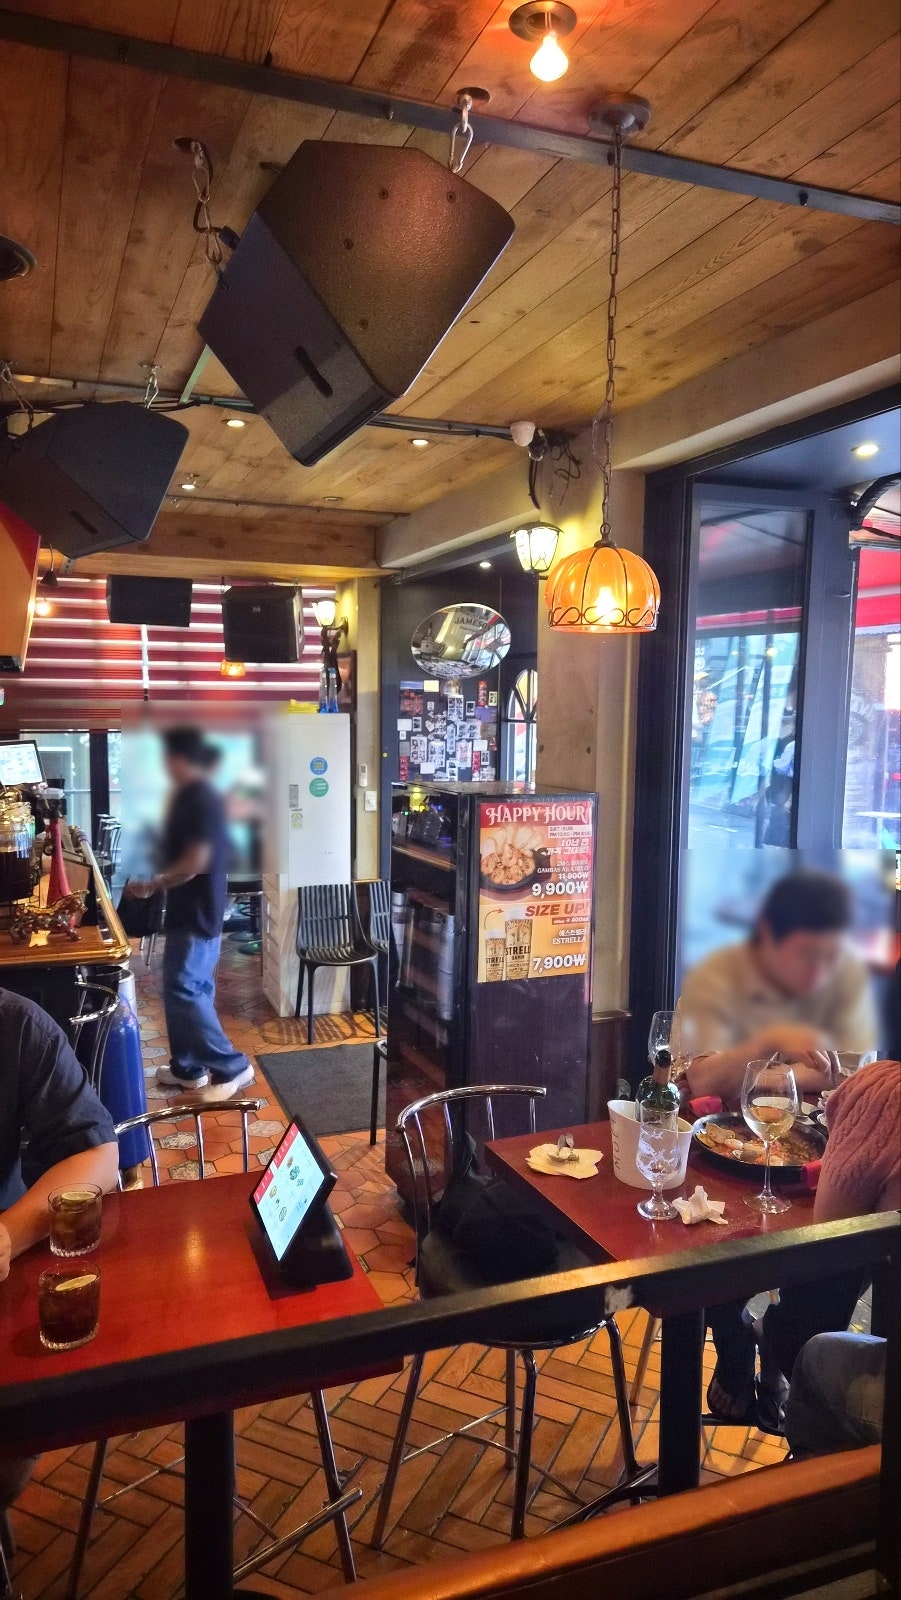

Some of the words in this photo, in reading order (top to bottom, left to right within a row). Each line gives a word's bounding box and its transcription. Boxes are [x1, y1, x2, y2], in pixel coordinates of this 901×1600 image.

[485, 804, 541, 825] HAPPY
[544, 803, 587, 824] HOUR
[525, 904, 561, 917] SIZE
[564, 902, 588, 914] UP!
[552, 935, 587, 945] ESTRELLA
